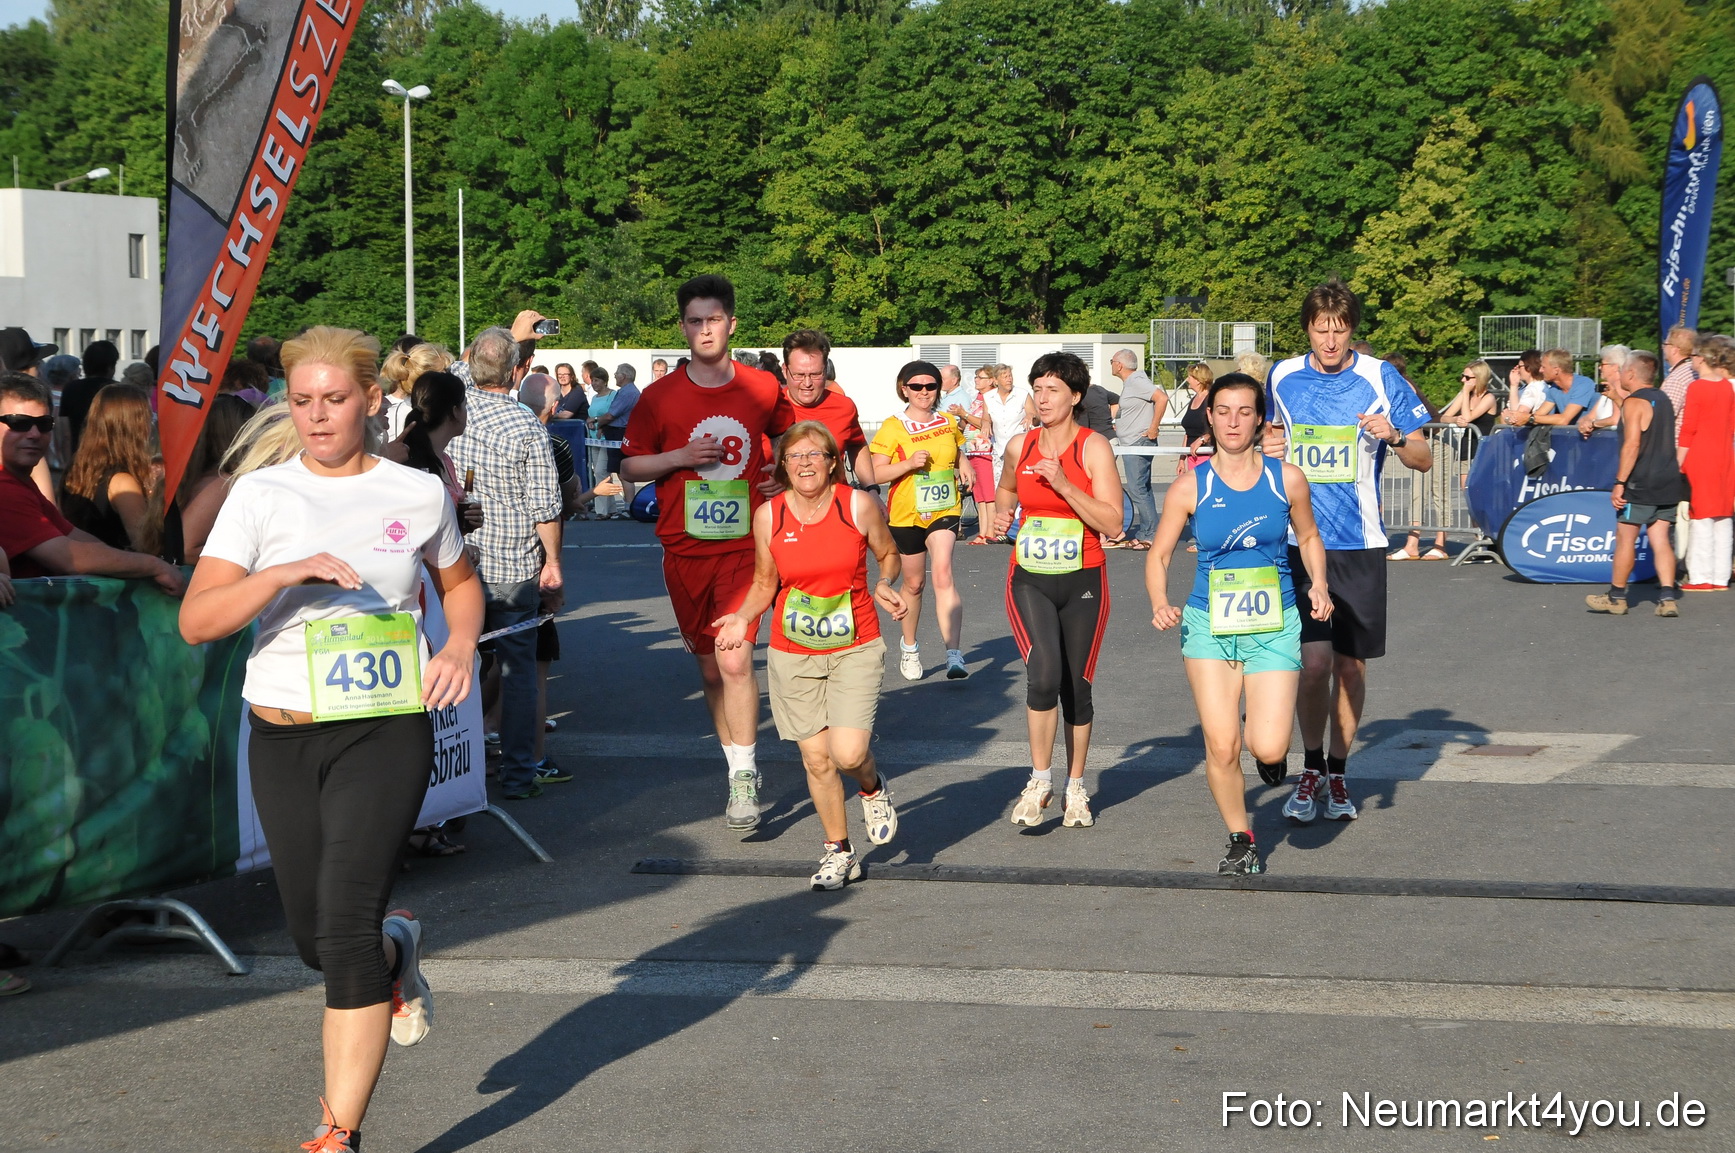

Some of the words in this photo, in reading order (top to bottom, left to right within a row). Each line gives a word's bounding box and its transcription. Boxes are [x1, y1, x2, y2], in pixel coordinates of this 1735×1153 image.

[911, 434, 932, 444] MAX
[1293, 445, 1349, 468] 1041
[920, 484, 950, 502] 799
[1517, 475, 1595, 503] Fisch
[694, 501, 740, 524] 462
[1232, 519, 1253, 535] Schick
[1019, 537, 1078, 560] 1319
[1219, 590, 1270, 618] 740
[786, 611, 850, 638] 1303
[325, 649, 402, 692] 430
